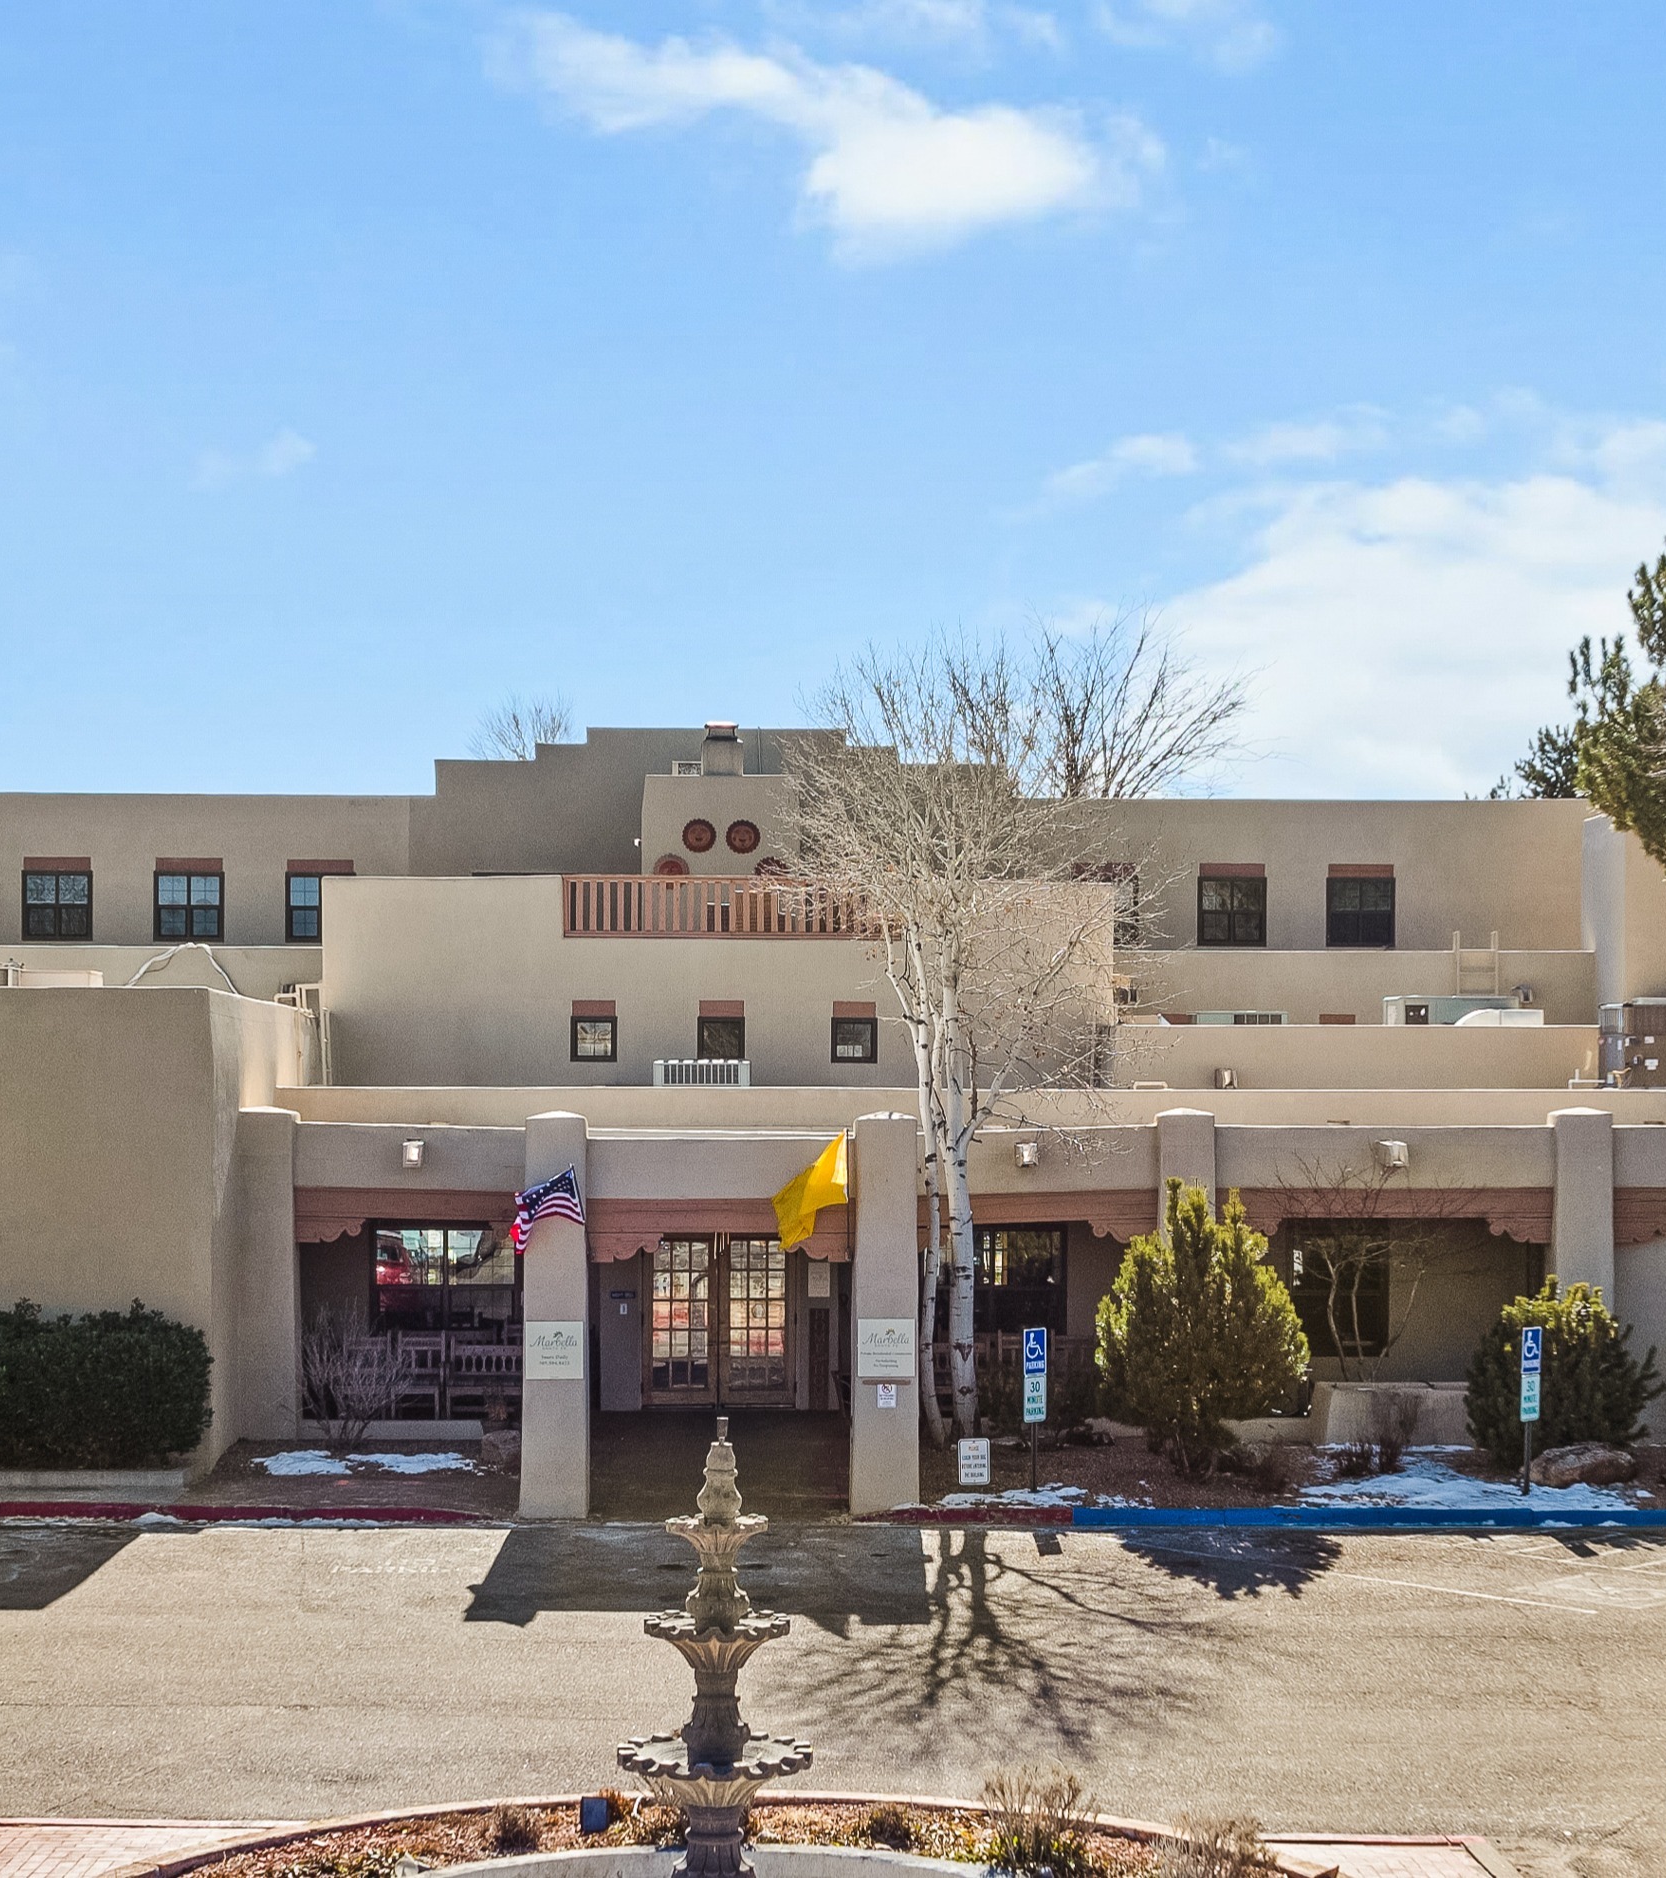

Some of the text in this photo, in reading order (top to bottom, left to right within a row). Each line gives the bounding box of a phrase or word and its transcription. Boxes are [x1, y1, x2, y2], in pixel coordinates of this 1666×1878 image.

[529, 1335, 577, 1348] Marbella
[862, 1332, 910, 1345] Marbella
[1026, 1360, 1045, 1370] PARKING
[1030, 1381, 1041, 1393] 30
[1026, 1405, 1044, 1416] PARKING
